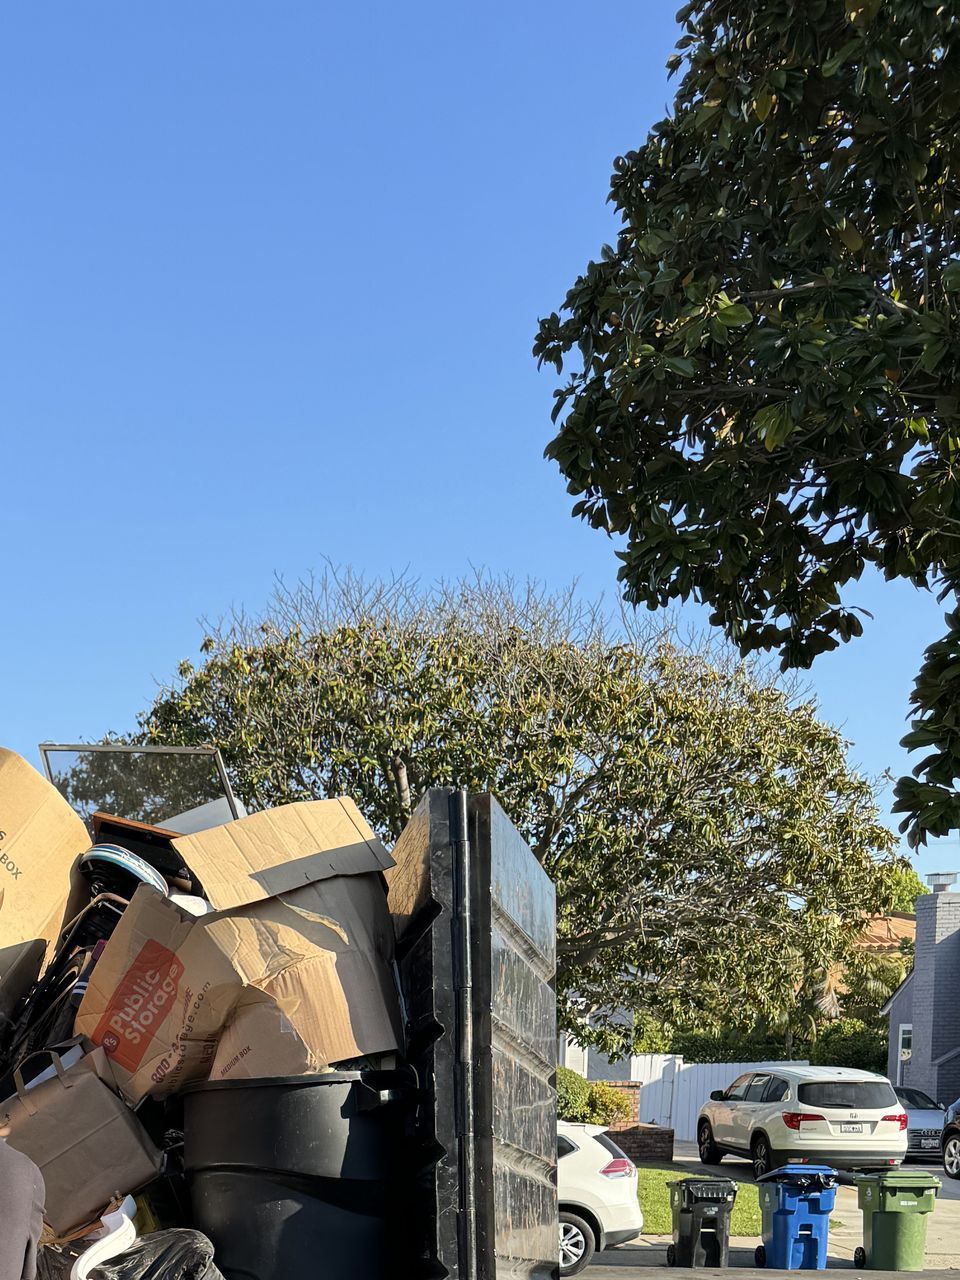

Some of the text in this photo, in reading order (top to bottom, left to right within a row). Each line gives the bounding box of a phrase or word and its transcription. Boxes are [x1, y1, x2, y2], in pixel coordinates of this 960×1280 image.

[0, 853, 22, 880] BOX
[109, 969, 161, 1034] Public
[124, 964, 178, 1045] Storage
[238, 1044, 253, 1058] BOX
